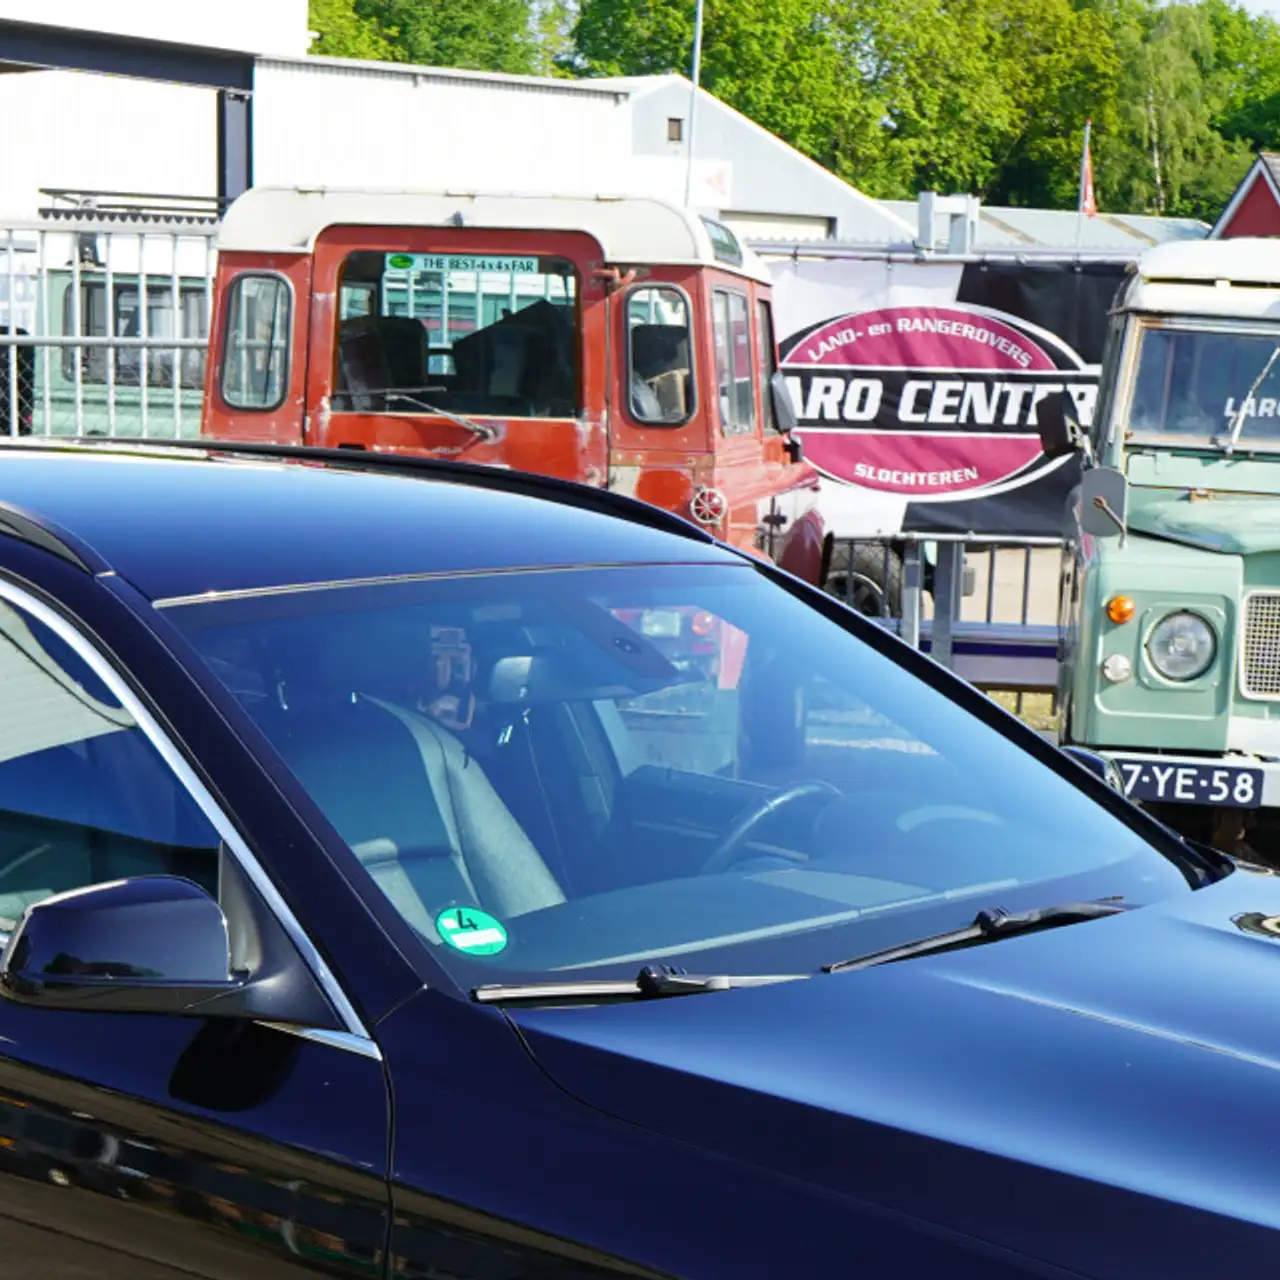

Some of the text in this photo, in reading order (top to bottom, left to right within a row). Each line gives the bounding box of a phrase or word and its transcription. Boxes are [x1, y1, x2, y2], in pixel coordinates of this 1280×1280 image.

[423, 257, 445, 269] THE
[807, 316, 1034, 369] LAND- en RANGEROVERS
[783, 375, 885, 422] ARO
[853, 461, 980, 486] SLOCHTEREN
[456, 908, 478, 930] 4
